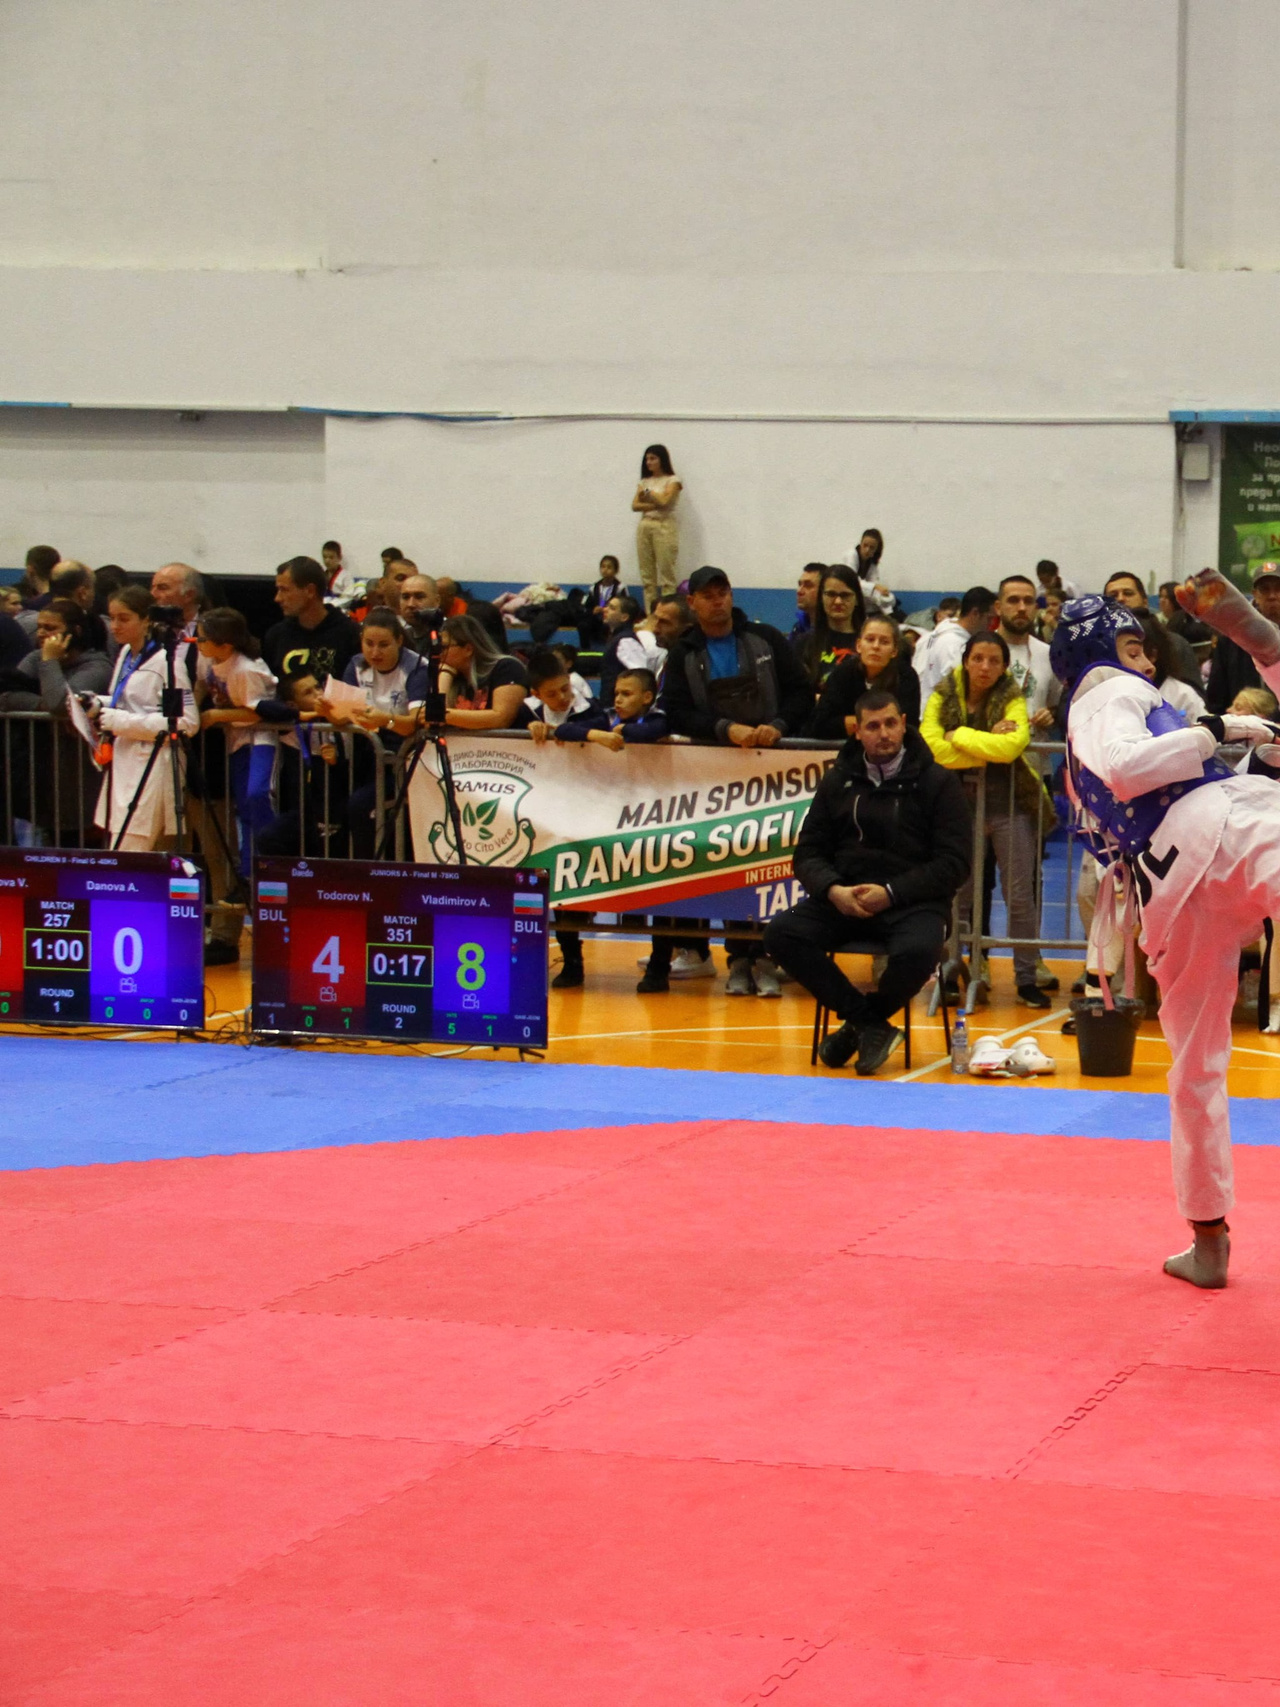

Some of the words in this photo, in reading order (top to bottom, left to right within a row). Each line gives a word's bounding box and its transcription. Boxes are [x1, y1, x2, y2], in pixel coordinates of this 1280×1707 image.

[452, 780, 516, 795] RAMUS
[617, 791, 699, 829] MAIN
[553, 829, 697, 893] RAMUS
[745, 864, 794, 886] INTERN
[17, 878, 29, 887] V.
[86, 881, 125, 891] Danova
[127, 882, 139, 892] A.
[317, 890, 360, 901] Todorov
[362, 892, 373, 902] N.
[422, 895, 476, 907] Vladimirov
[479, 898, 491, 907] A.
[40, 901, 75, 910] MATCH
[170, 905, 199, 918] BUL
[44, 913, 71, 927] 257
[259, 909, 288, 922] BUL
[383, 915, 418, 925] MATCH
[514, 920, 543, 933] BUL
[387, 928, 413, 942] 351
[31, 938, 84, 962] 1:00
[113, 926, 143, 975] 0
[312, 935, 345, 984] 4
[373, 953, 426, 977] 0:17
[456, 942, 487, 991] 8
[40, 988, 75, 998] ROUND
[0, 1001, 10, 1013] 0
[53, 1001, 60, 1013] 1
[105, 1006, 114, 1018] 0
[382, 1003, 416, 1014] ROUND
[143, 1008, 151, 1020] 0
[179, 1009, 188, 1021] 0
[268, 1013, 275, 1025] 1
[305, 1016, 313, 1028] 0
[343, 1018, 350, 1029] 1
[395, 1017, 403, 1029] 2
[447, 1023, 456, 1035] 5
[486, 1025, 492, 1036] 1
[522, 1026, 531, 1038] 0
